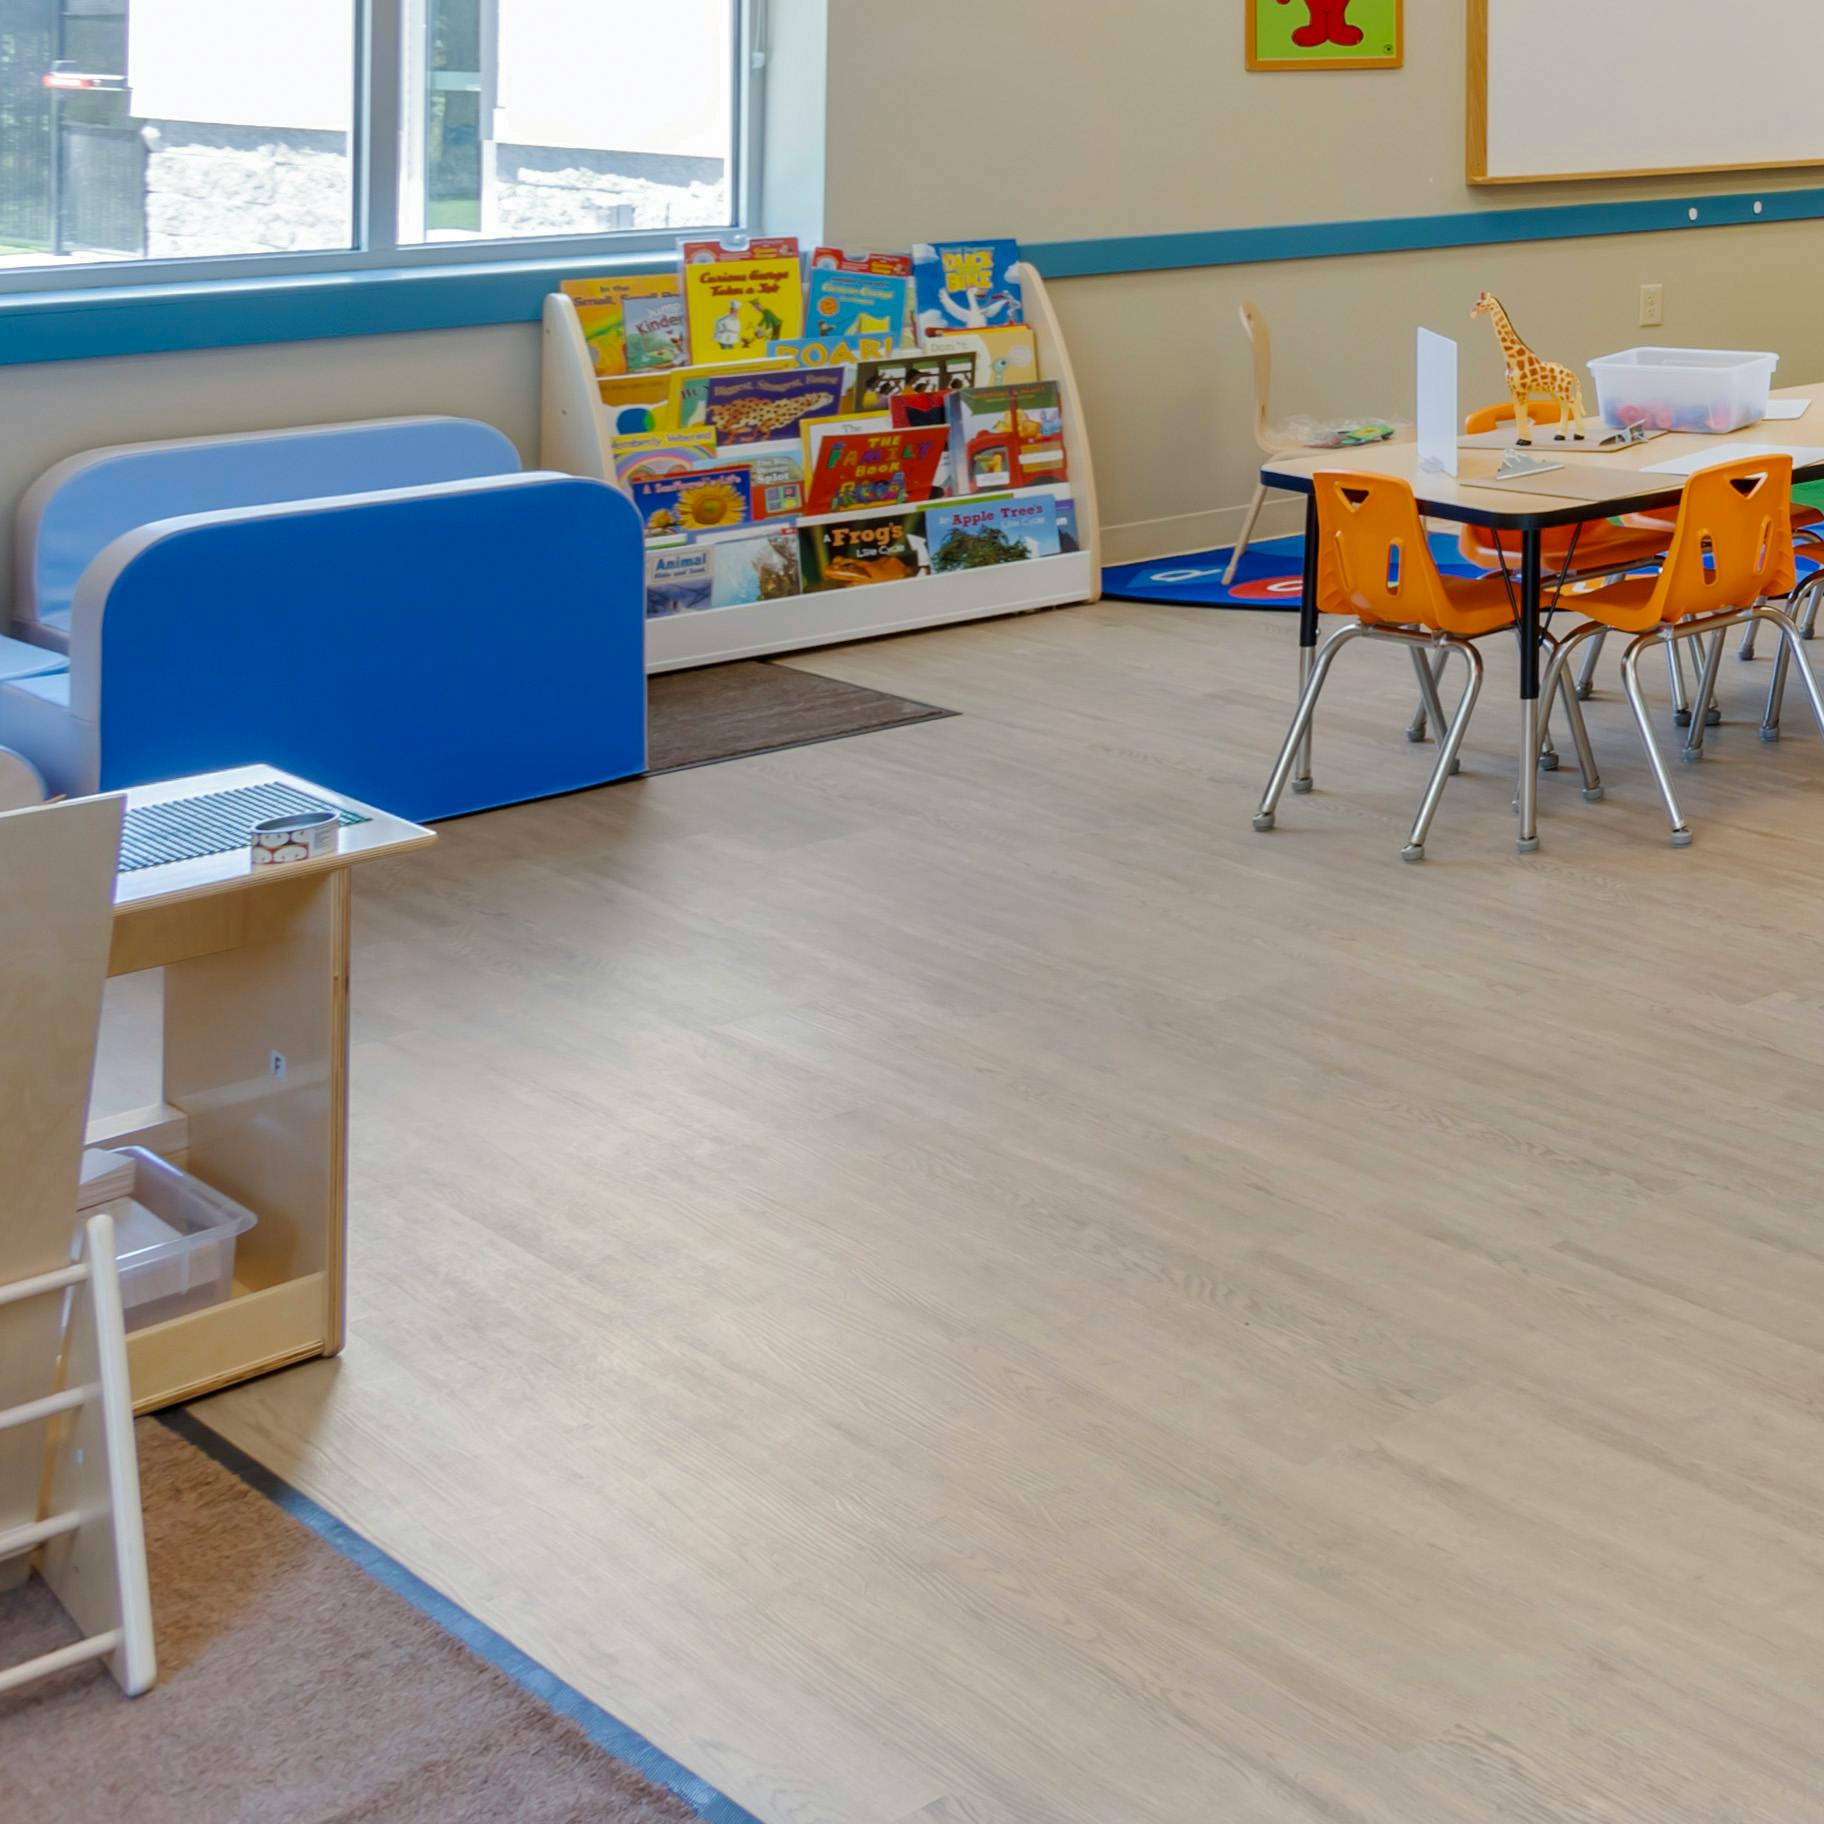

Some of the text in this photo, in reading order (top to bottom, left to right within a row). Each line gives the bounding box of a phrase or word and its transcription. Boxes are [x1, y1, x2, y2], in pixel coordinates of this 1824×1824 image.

[868, 436, 901, 449] THE
[827, 440, 935, 470] FAMILY
[952, 504, 1044, 528] Apple Tree's
[823, 522, 904, 547] A Frog's
[655, 552, 707, 571] Animal
